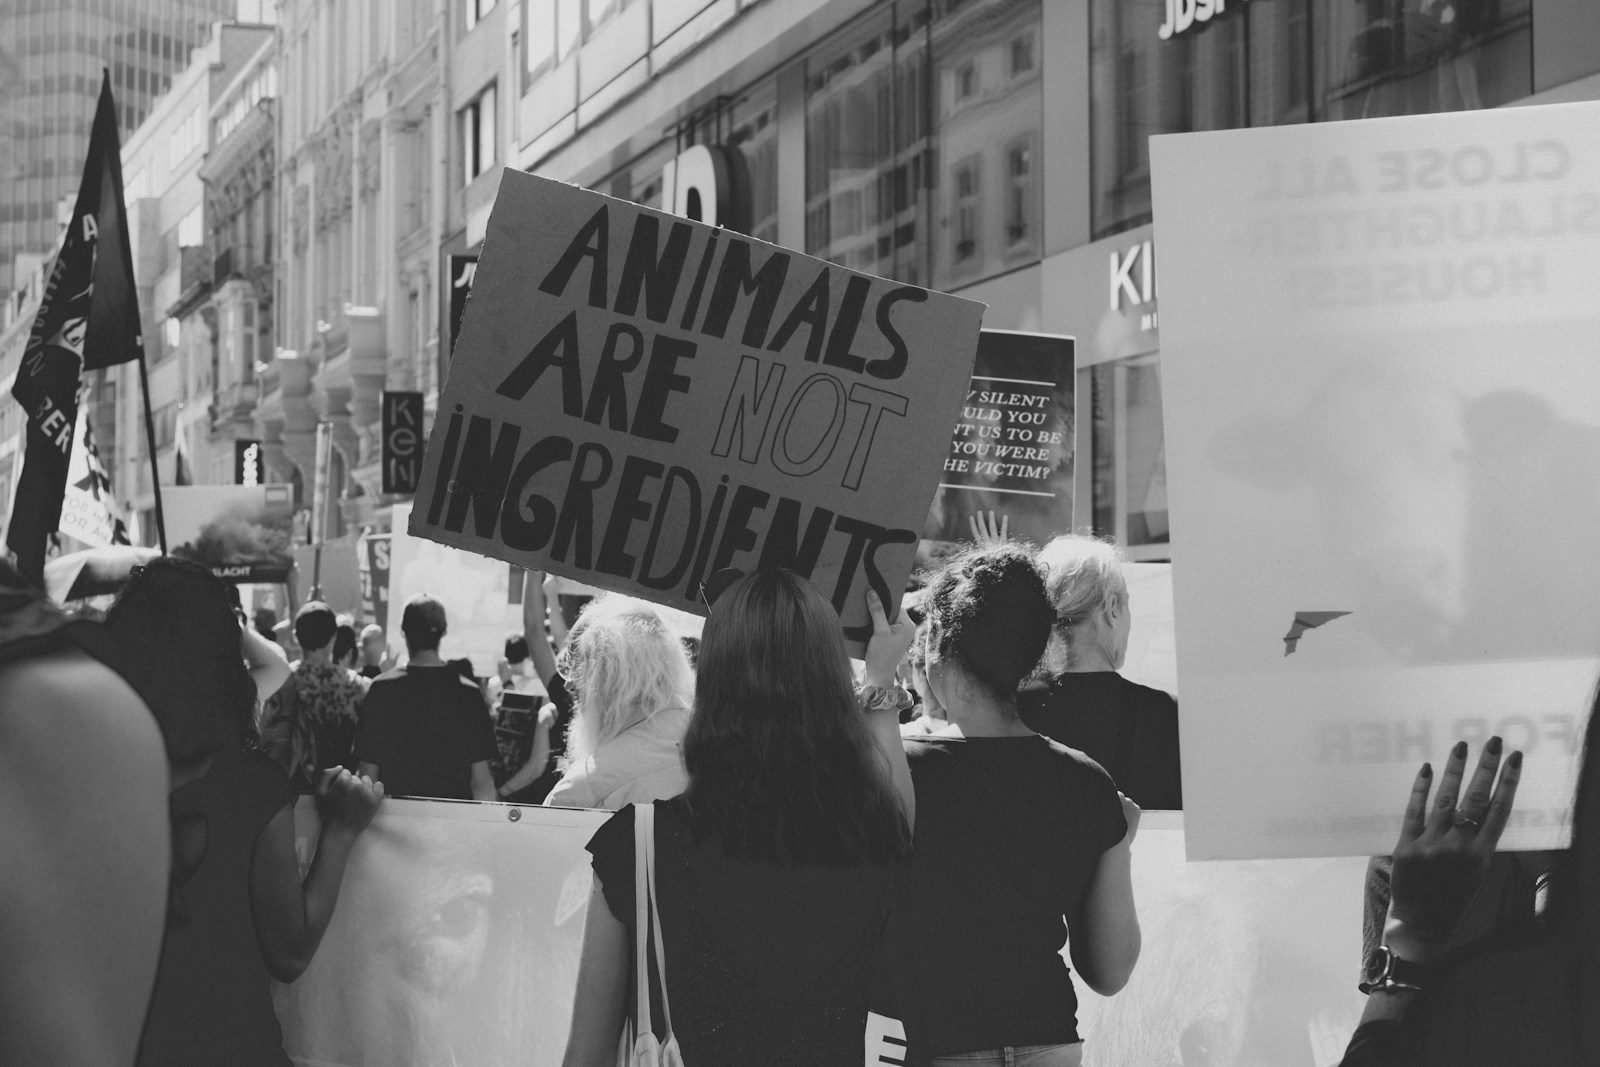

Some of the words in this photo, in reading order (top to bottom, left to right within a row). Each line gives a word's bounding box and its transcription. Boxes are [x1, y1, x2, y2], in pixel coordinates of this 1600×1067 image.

[495, 310, 698, 444] ARE
[711, 355, 909, 491] NOT
[979, 391, 1050, 408] SILENT
[1007, 410, 1047, 425] YOU
[979, 425, 1002, 439] US
[1007, 428, 1033, 441] TO
[1036, 431, 1062, 445] BE
[953, 441, 990, 455] YOU
[995, 444, 1050, 461] WERE
[974, 460, 1050, 479] VICTIM?
